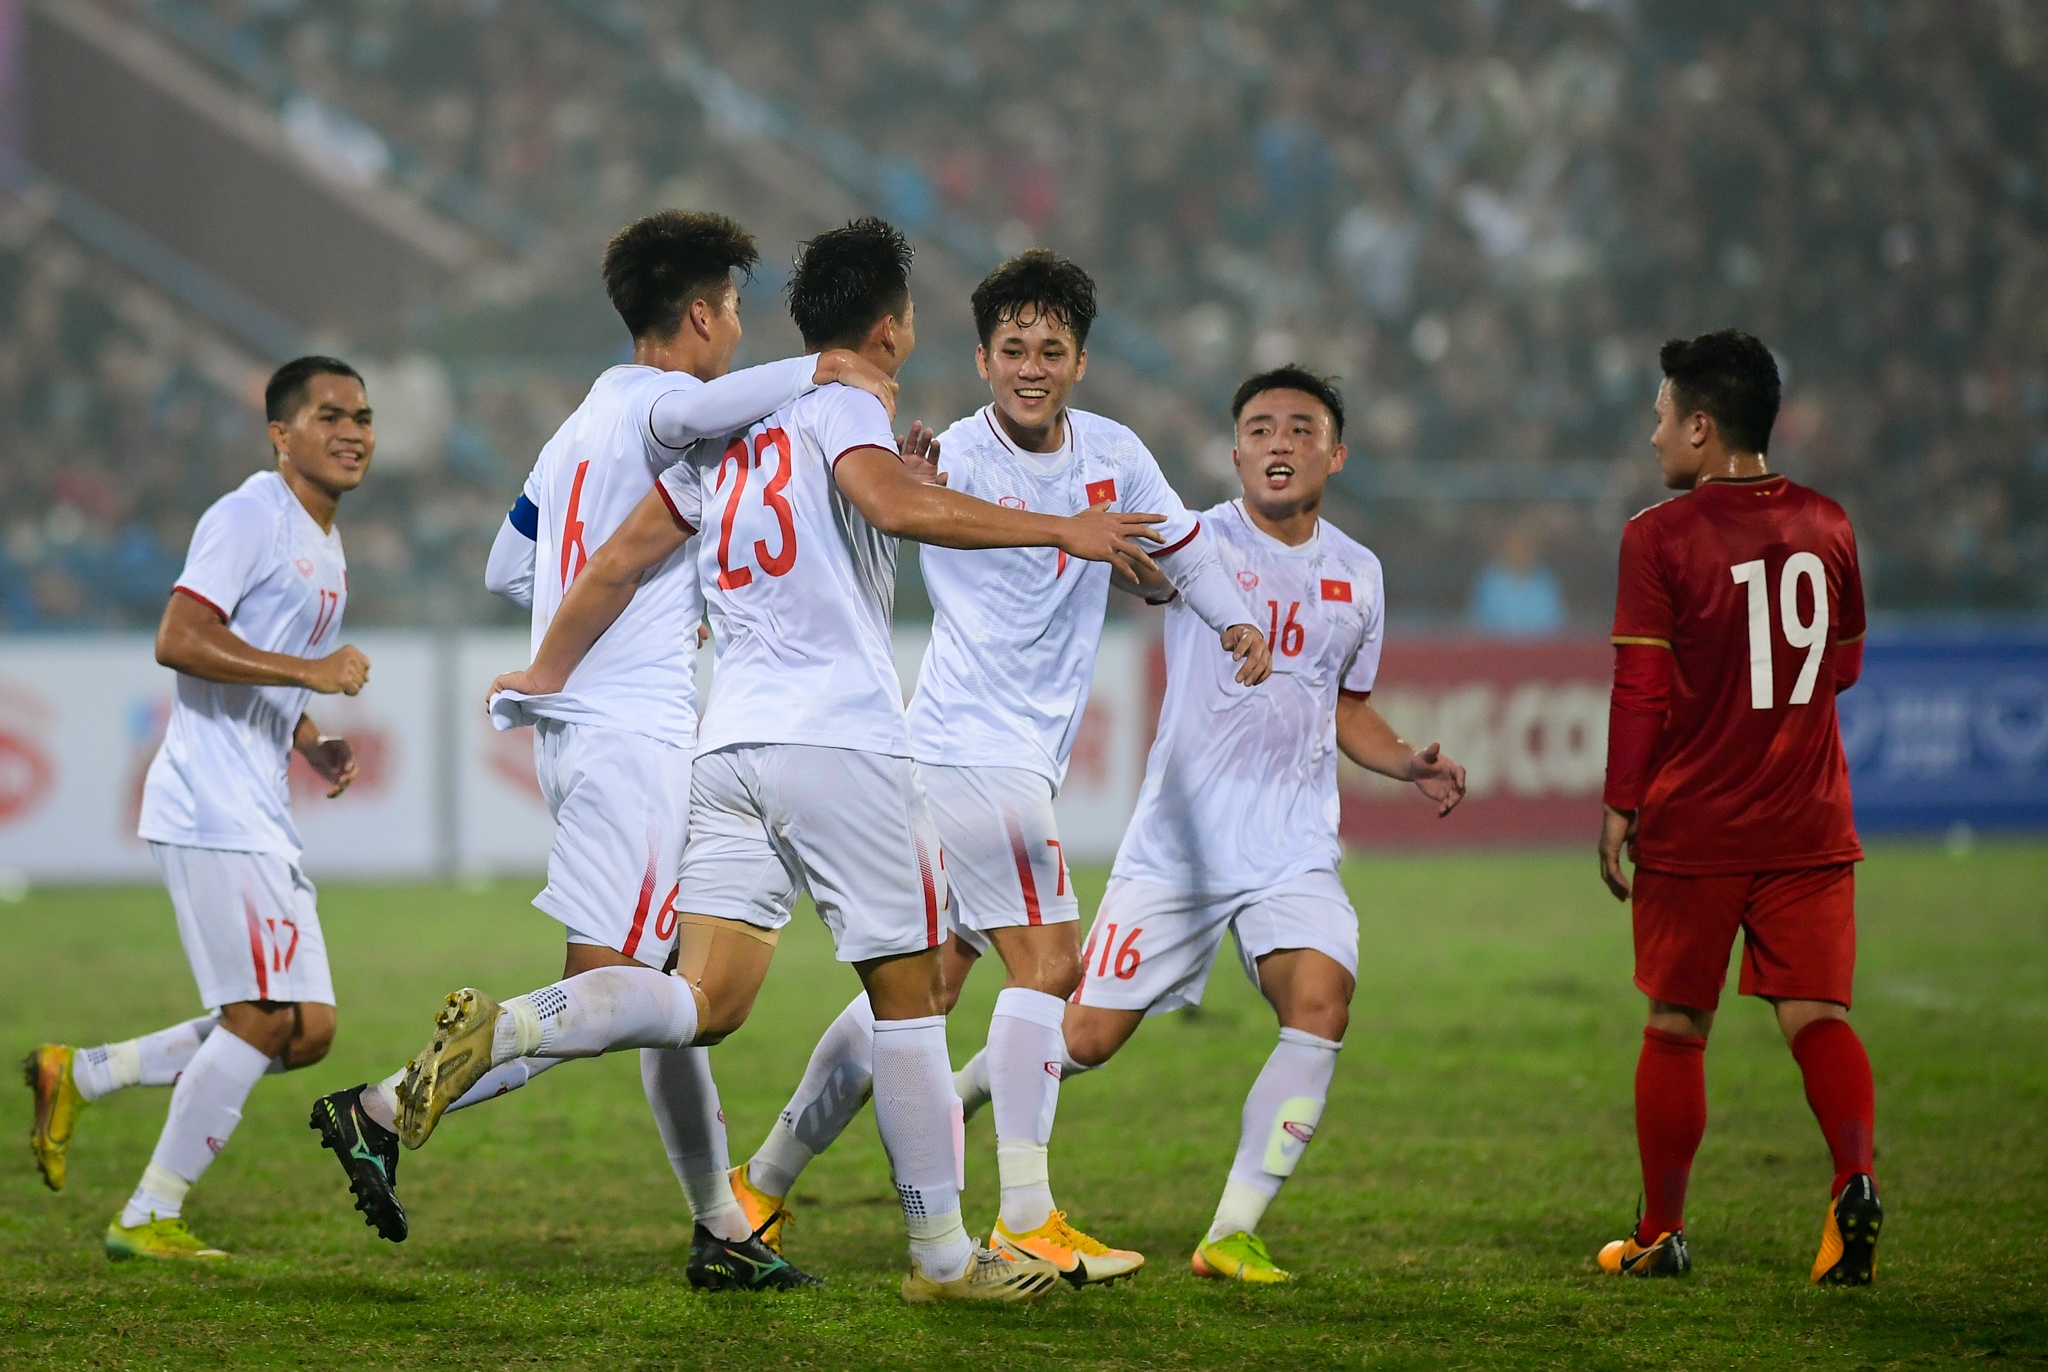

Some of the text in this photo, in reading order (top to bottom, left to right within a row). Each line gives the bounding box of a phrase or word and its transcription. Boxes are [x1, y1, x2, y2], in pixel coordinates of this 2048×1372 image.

[715, 428, 797, 591] 23
[307, 589, 337, 647] 17
[1267, 600, 1304, 657] 16
[1730, 551, 1829, 710] 19
[1046, 839, 1065, 896] 7
[655, 882, 679, 941] 6
[266, 918, 298, 973] 17
[1097, 923, 1143, 980] 16
